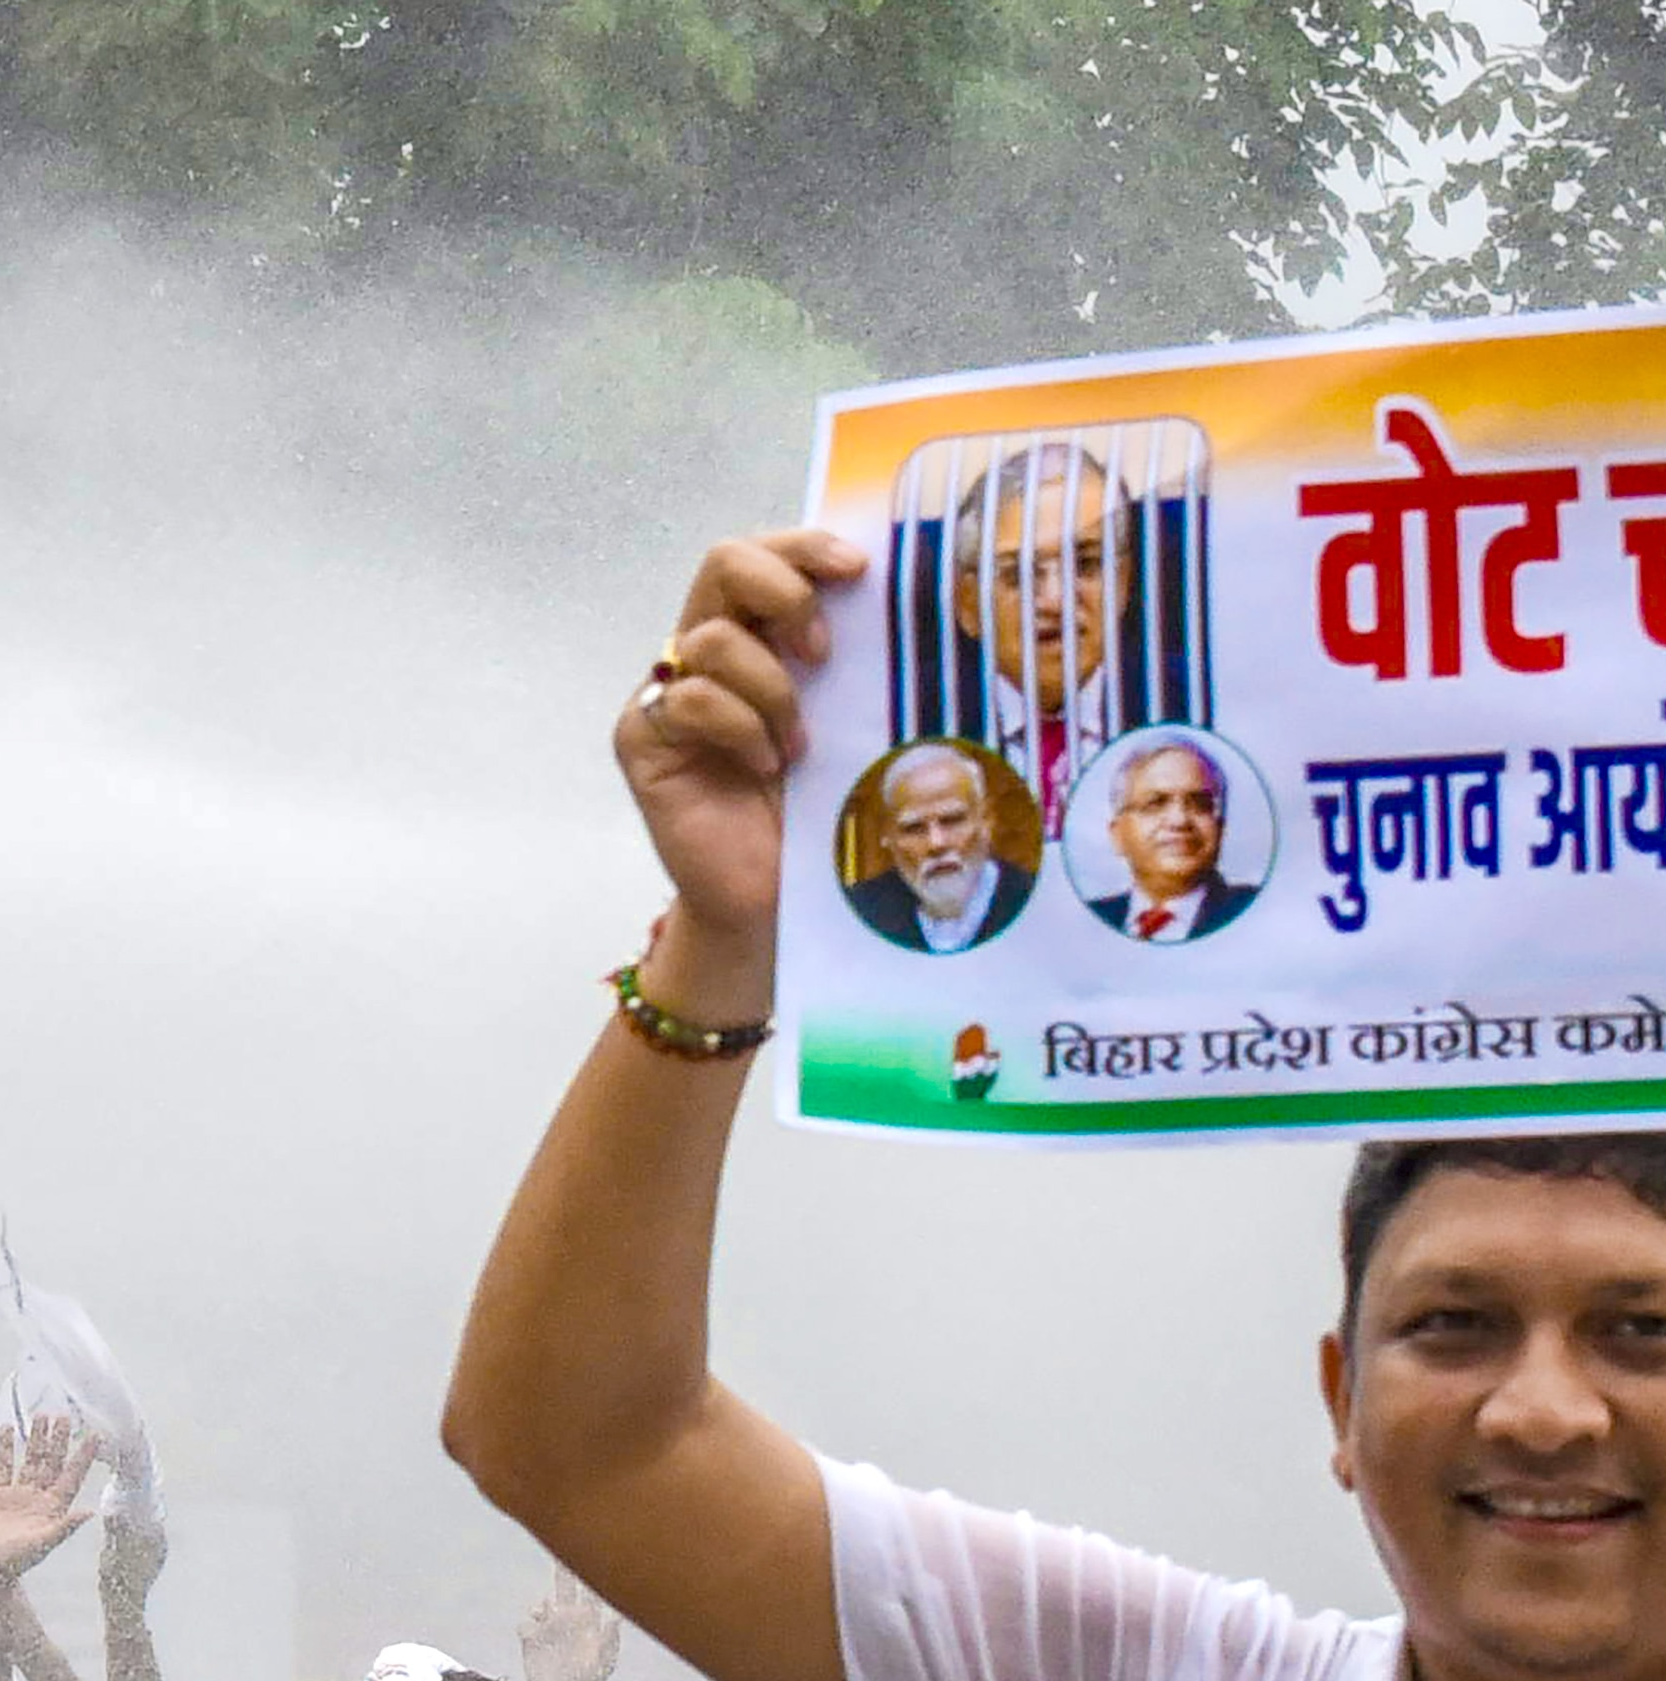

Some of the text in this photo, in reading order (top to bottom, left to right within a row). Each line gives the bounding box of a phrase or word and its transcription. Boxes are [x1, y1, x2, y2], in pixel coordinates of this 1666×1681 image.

[1299, 408, 1579, 680] वोट
[1305, 750, 1507, 933] चुनाव
[1043, 1022, 1185, 1079] बिहार
[1201, 1011, 1331, 1074] प्रदेश
[1349, 1002, 1539, 1063] कांग्रेस
